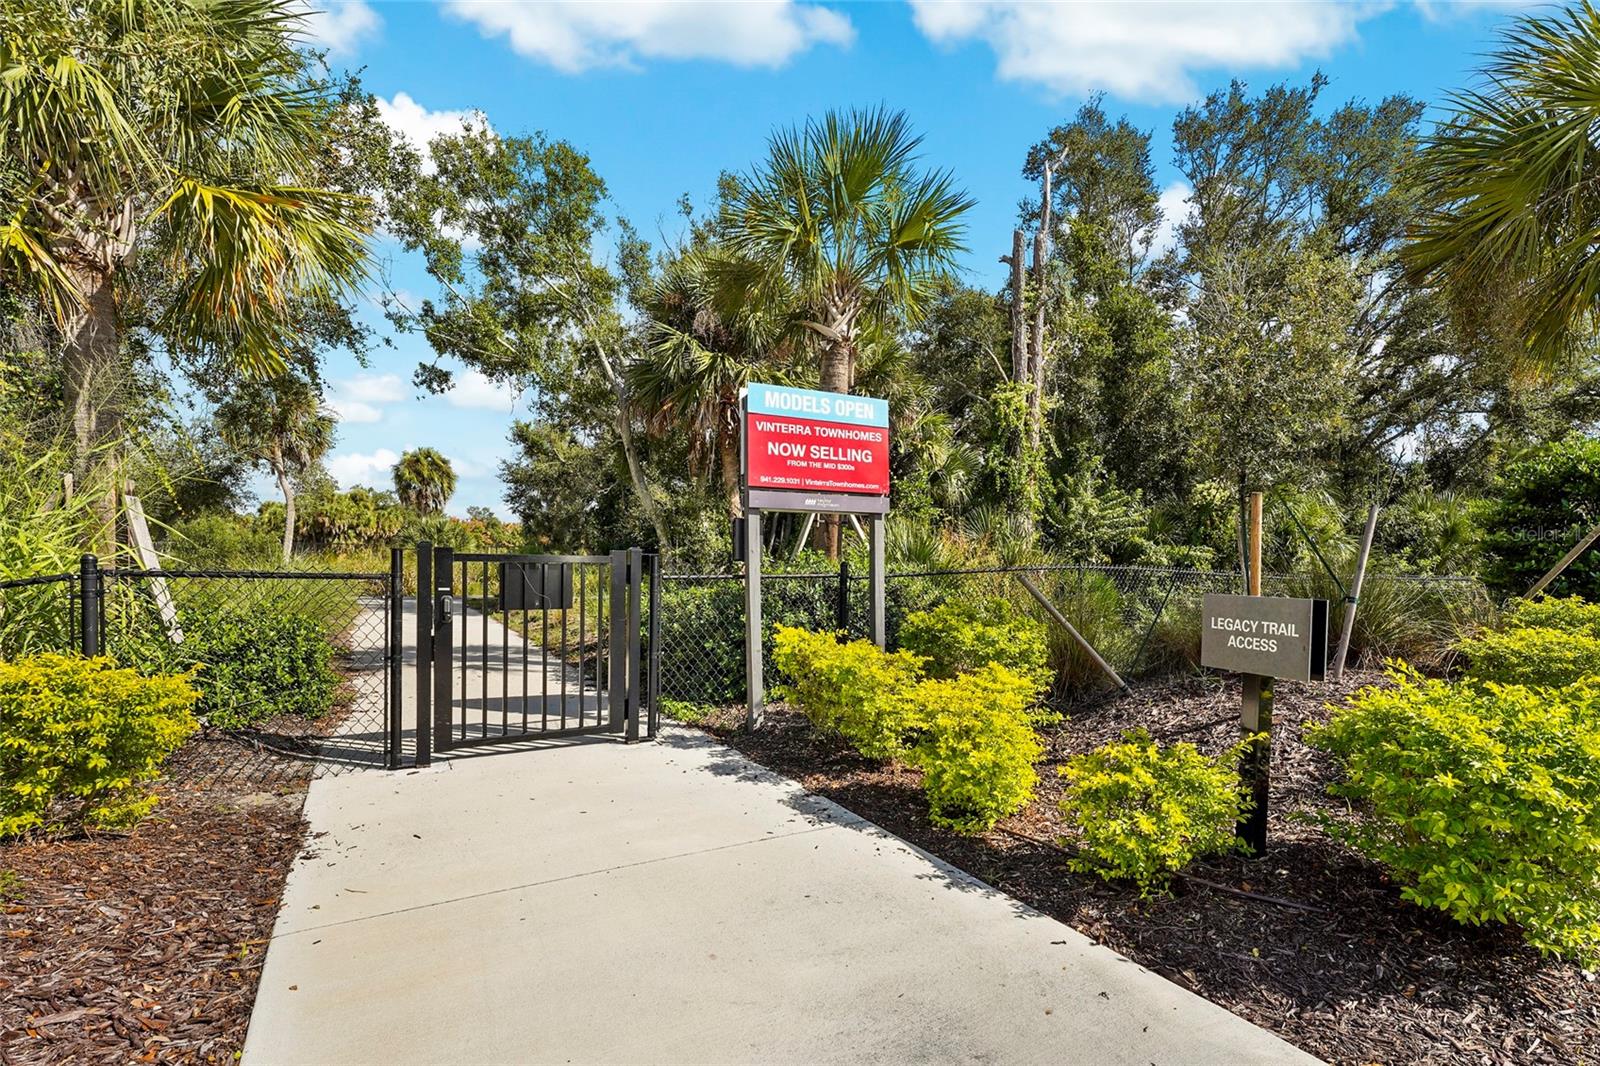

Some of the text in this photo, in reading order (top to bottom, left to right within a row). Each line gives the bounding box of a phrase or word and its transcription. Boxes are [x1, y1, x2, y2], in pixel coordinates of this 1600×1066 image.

[764, 390, 874, 419] MODELS OPEN
[756, 421, 882, 442] VINTERRA TOWNHOMES
[767, 442, 873, 463] NOW SELLING
[809, 461, 822, 469] THE
[823, 462, 836, 470] MID
[837, 463, 855, 471] $300s
[805, 478, 879, 490] VinterraTownhomes.com
[1211, 616, 1299, 638] LEGACY TRAIL
[1227, 635, 1278, 653] ACCESS
